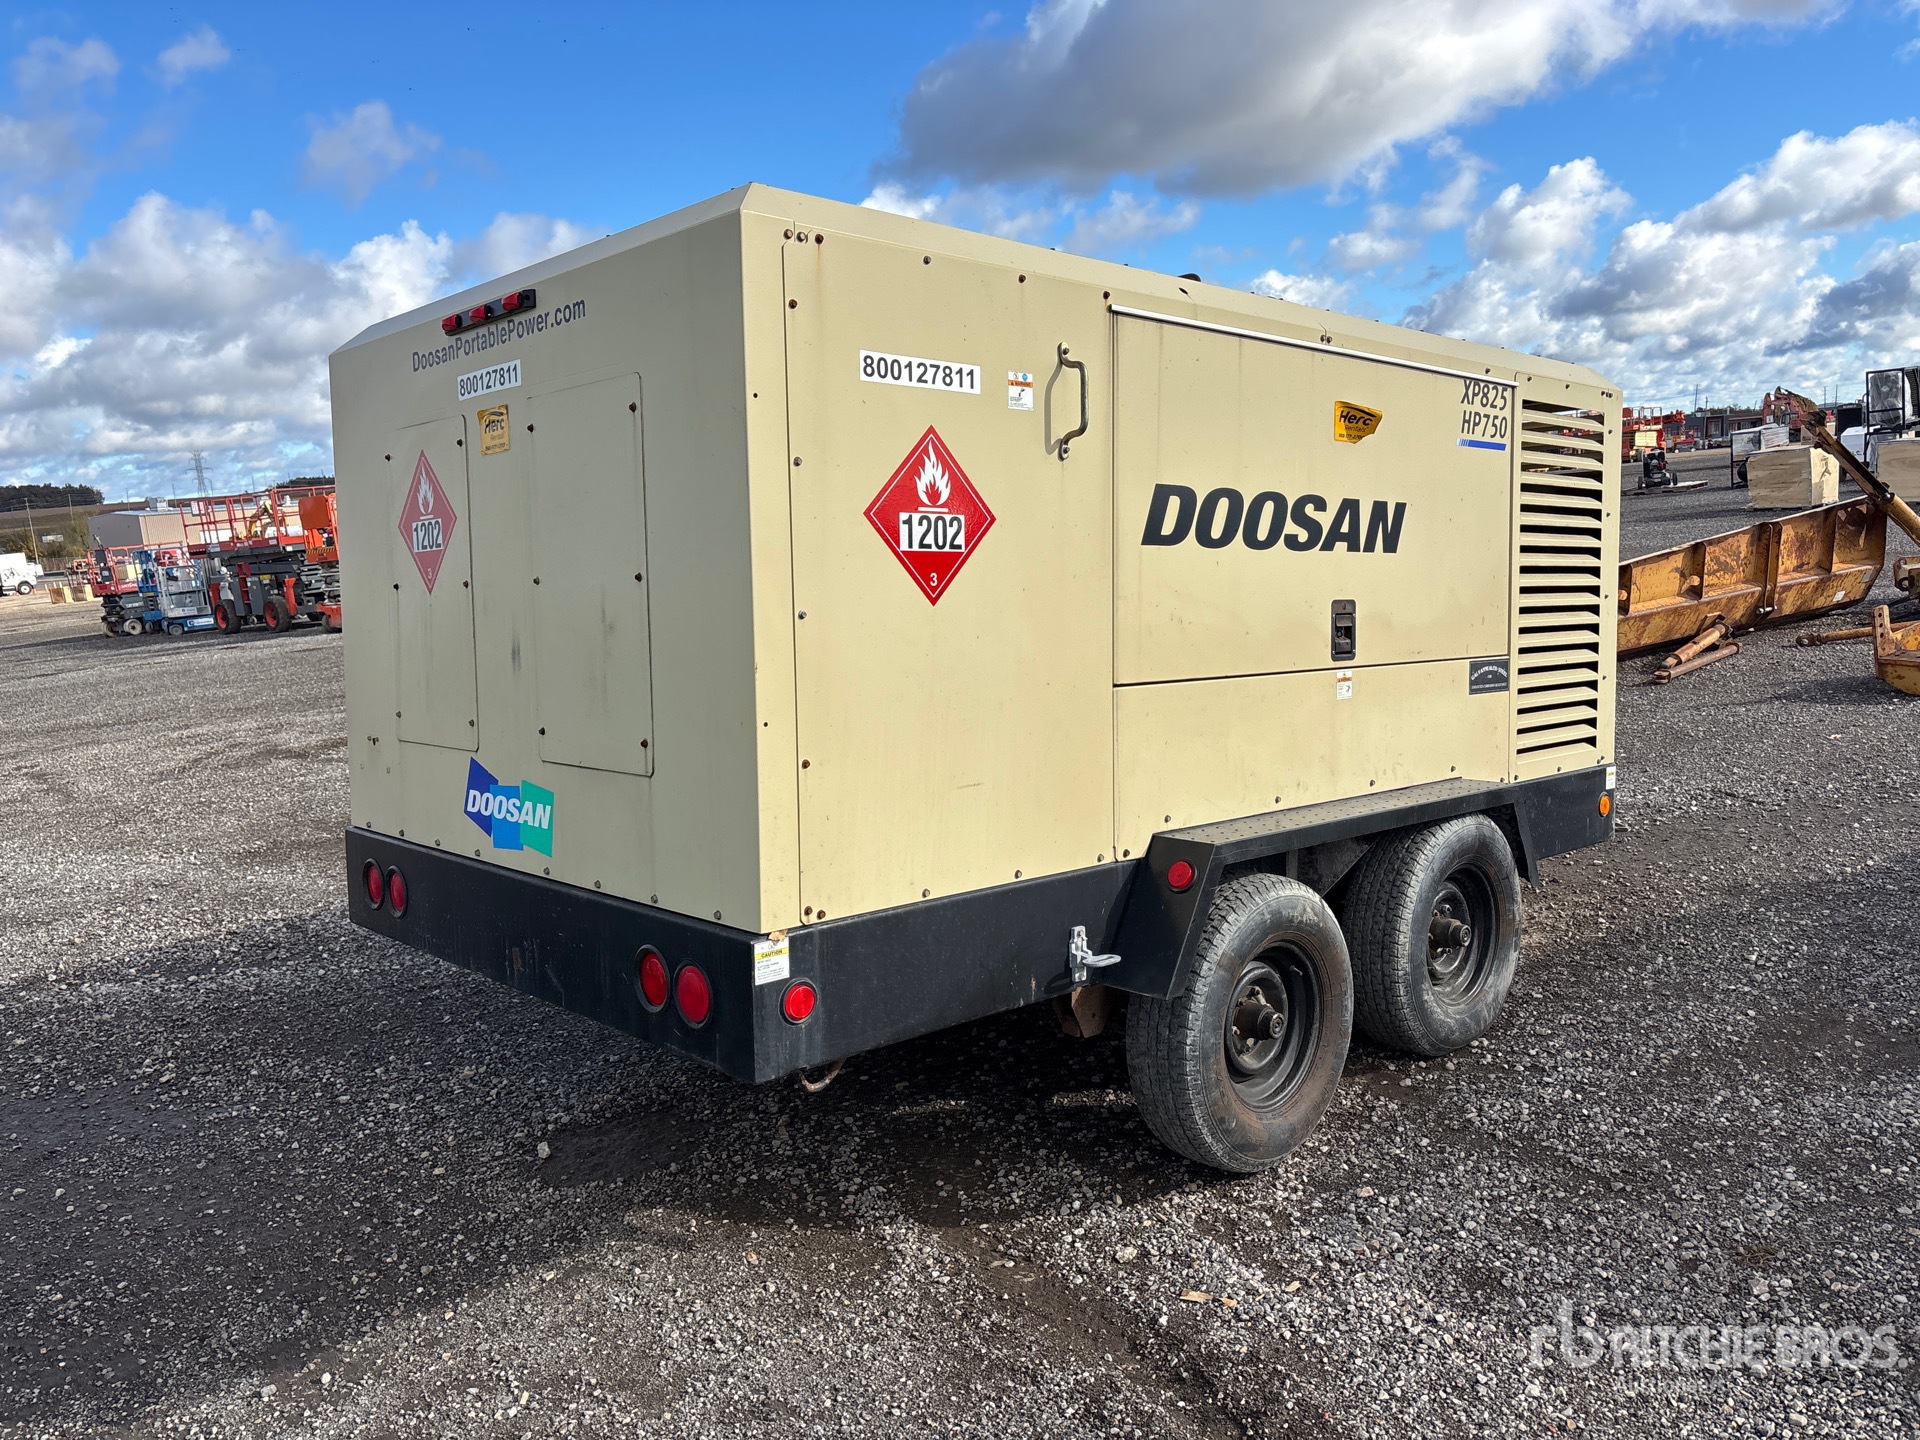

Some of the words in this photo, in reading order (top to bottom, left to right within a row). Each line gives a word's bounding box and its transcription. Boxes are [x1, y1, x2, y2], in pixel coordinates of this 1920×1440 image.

[412, 299, 586, 372] DoosanPortablePower.com
[459, 363, 519, 397] 800127811
[863, 355, 975, 390] 800127811
[1460, 379, 1508, 411] XP825
[484, 418, 505, 434] Herc
[1339, 410, 1373, 426] Herc
[1461, 410, 1508, 439] HP750
[902, 514, 963, 550] 1202
[1141, 483, 1407, 554] DOOSAN
[413, 520, 442, 550] 1202
[428, 568, 433, 579] 3
[929, 572, 938, 587] 3
[466, 789, 552, 830] DOOSAN
[761, 950, 783, 958] CAUTION
